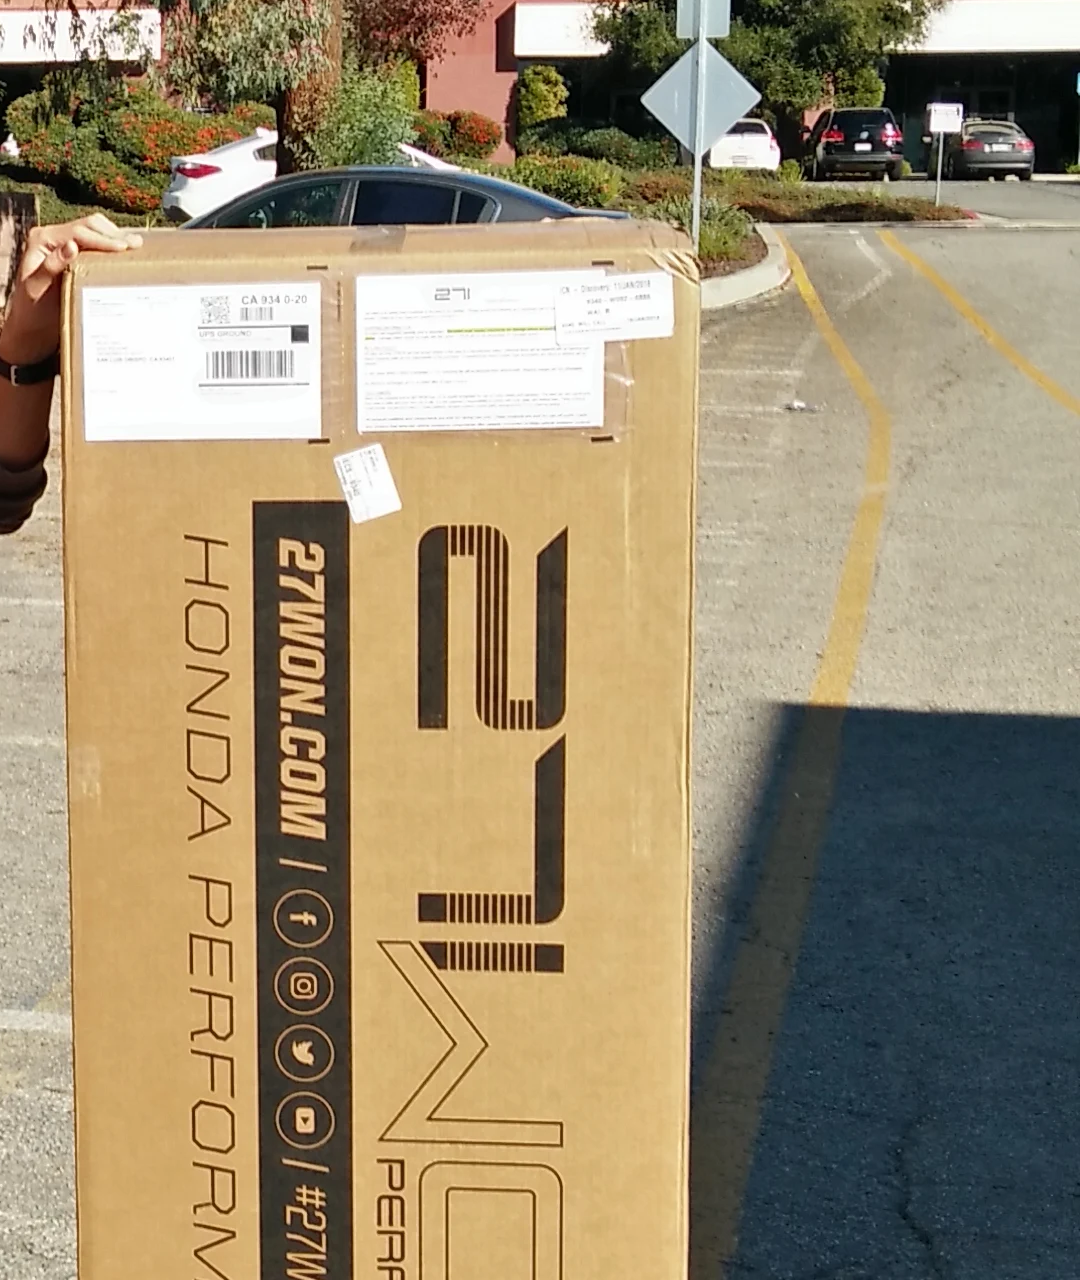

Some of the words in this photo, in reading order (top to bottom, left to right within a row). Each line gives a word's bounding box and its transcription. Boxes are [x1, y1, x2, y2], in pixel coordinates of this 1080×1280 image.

[241, 295, 258, 305] CA
[261, 295, 281, 305] 934
[183, 533, 233, 842] HONDA
[277, 536, 327, 842] 27WON.COM
